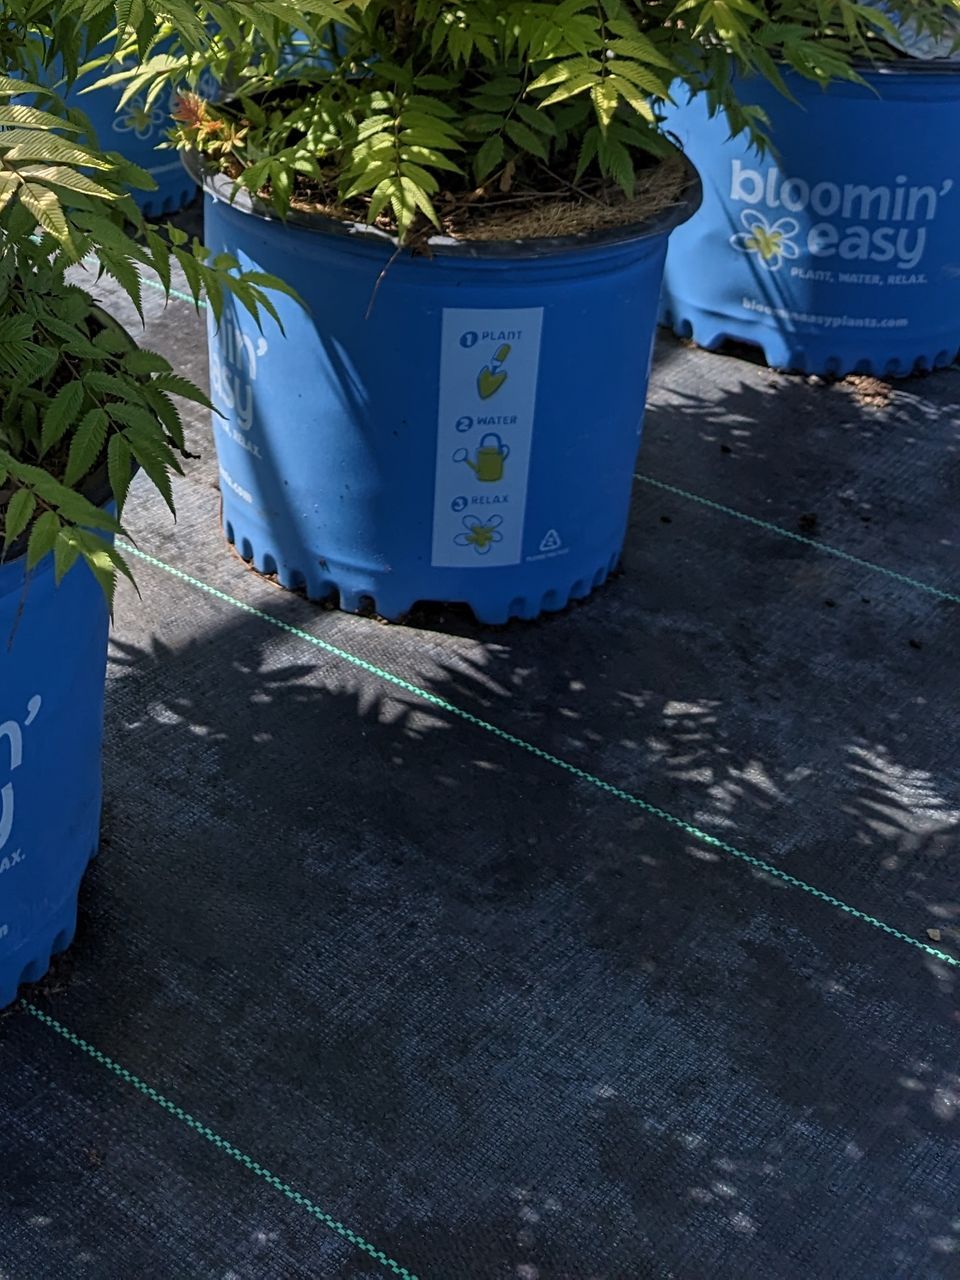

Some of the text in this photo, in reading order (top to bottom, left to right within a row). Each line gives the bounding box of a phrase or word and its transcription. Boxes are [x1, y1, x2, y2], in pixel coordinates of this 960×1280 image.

[730, 160, 953, 221] bloomin'
[807, 222, 927, 269] easy
[482, 330, 522, 341] PLANT
[477, 415, 517, 425] WATER
[472, 495, 509, 505] RELAX
